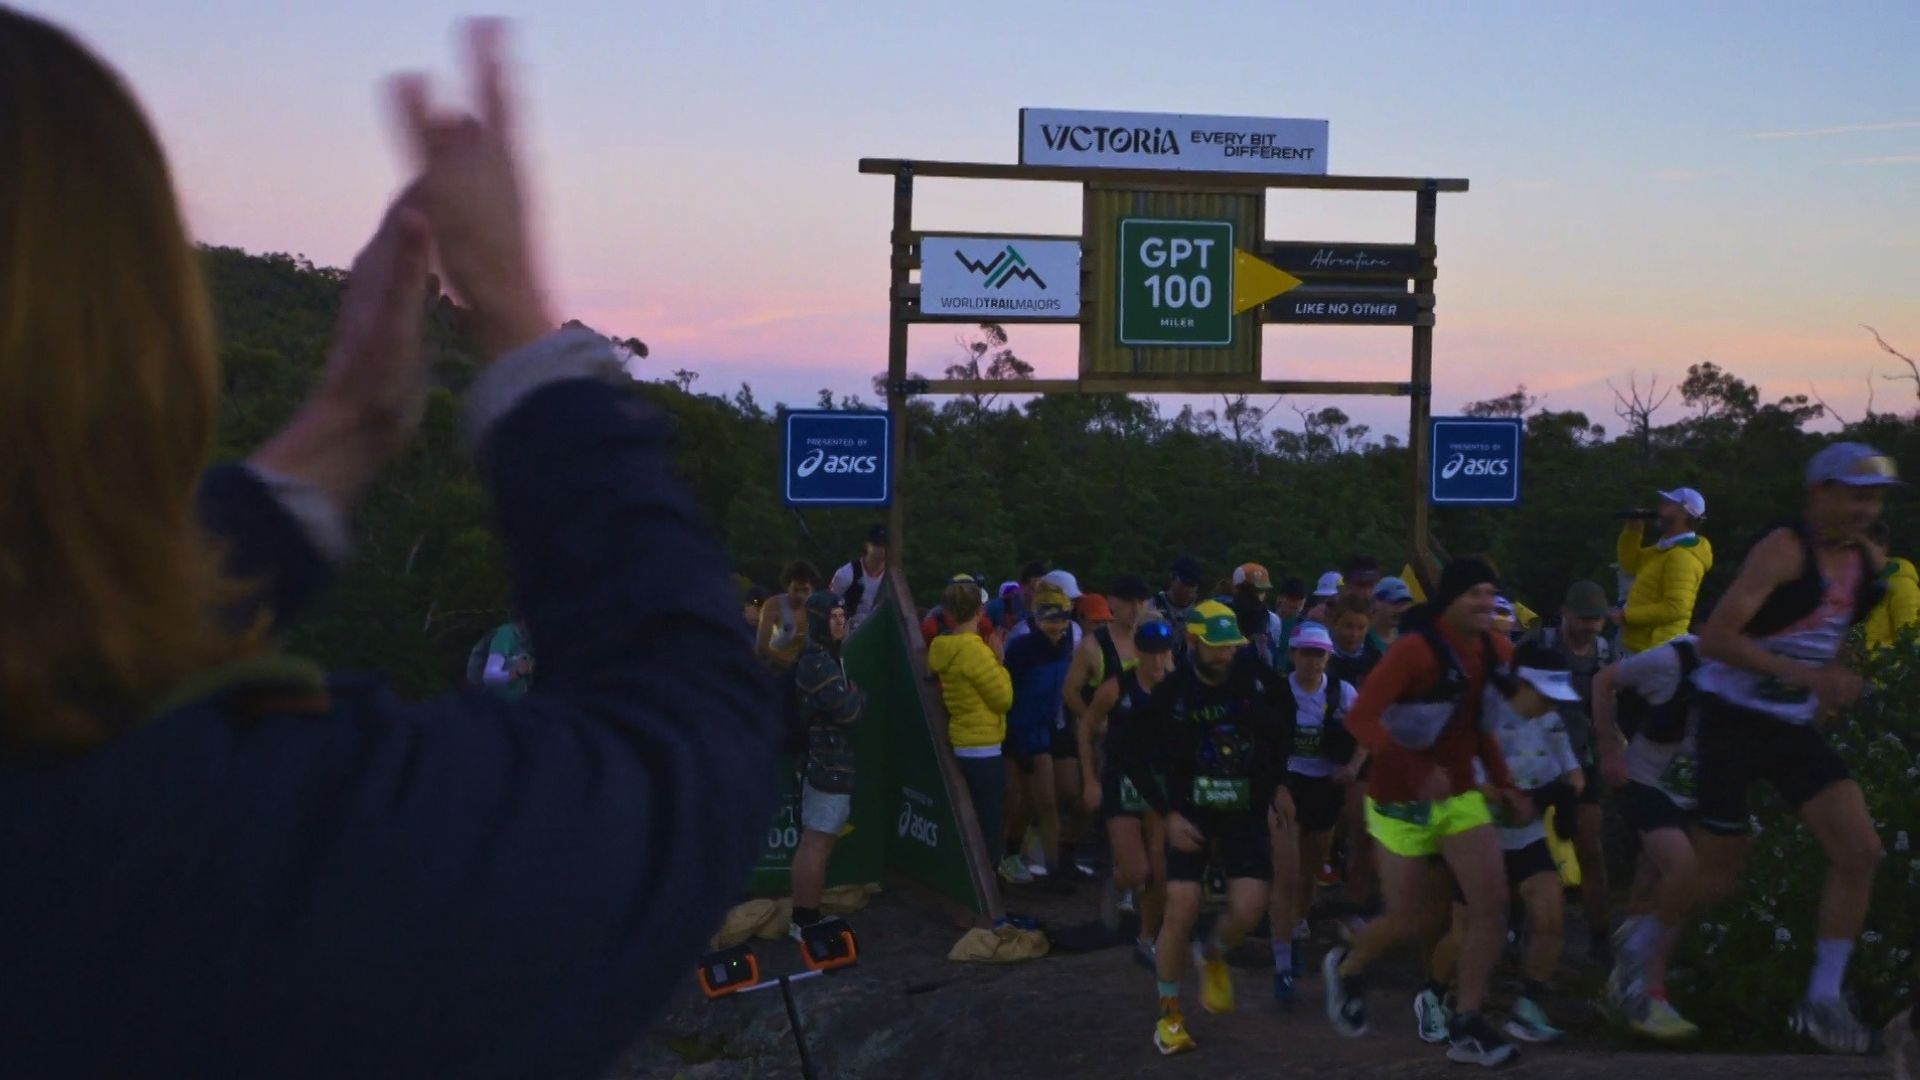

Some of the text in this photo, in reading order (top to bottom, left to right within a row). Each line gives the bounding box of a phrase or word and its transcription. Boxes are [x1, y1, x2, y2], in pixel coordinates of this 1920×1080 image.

[1190, 130, 1277, 146] EVERY BIT
[1223, 146, 1315, 160] DIFFERENT
[1139, 237, 1215, 269] GPT
[1310, 249, 1391, 270] Adventure
[1144, 274, 1212, 309] 100
[1295, 303, 1397, 316] LIKE NO OTHER
[1160, 318, 1195, 328] MILER
